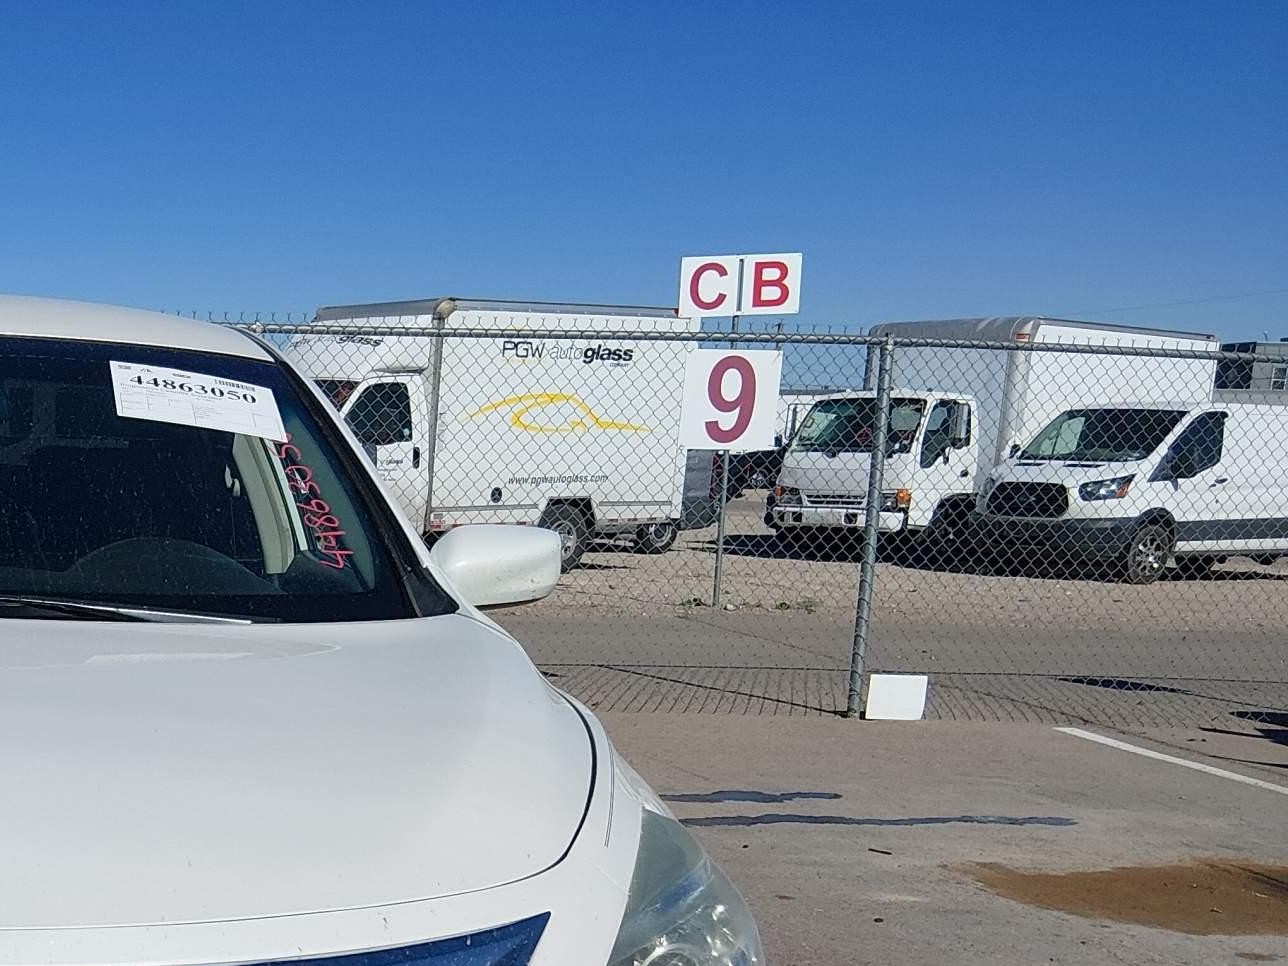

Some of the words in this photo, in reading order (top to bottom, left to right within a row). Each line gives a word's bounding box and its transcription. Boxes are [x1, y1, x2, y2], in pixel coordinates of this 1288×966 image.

[689, 262, 728, 310] C
[752, 261, 789, 308] B
[502, 341, 545, 358] PGW
[549, 344, 634, 364] autoglass
[129, 375, 257, 404] 44863050
[705, 355, 757, 444] 9
[508, 474, 609, 486] www.pgwautoglass.com
[268, 433, 354, 569] 4486305
